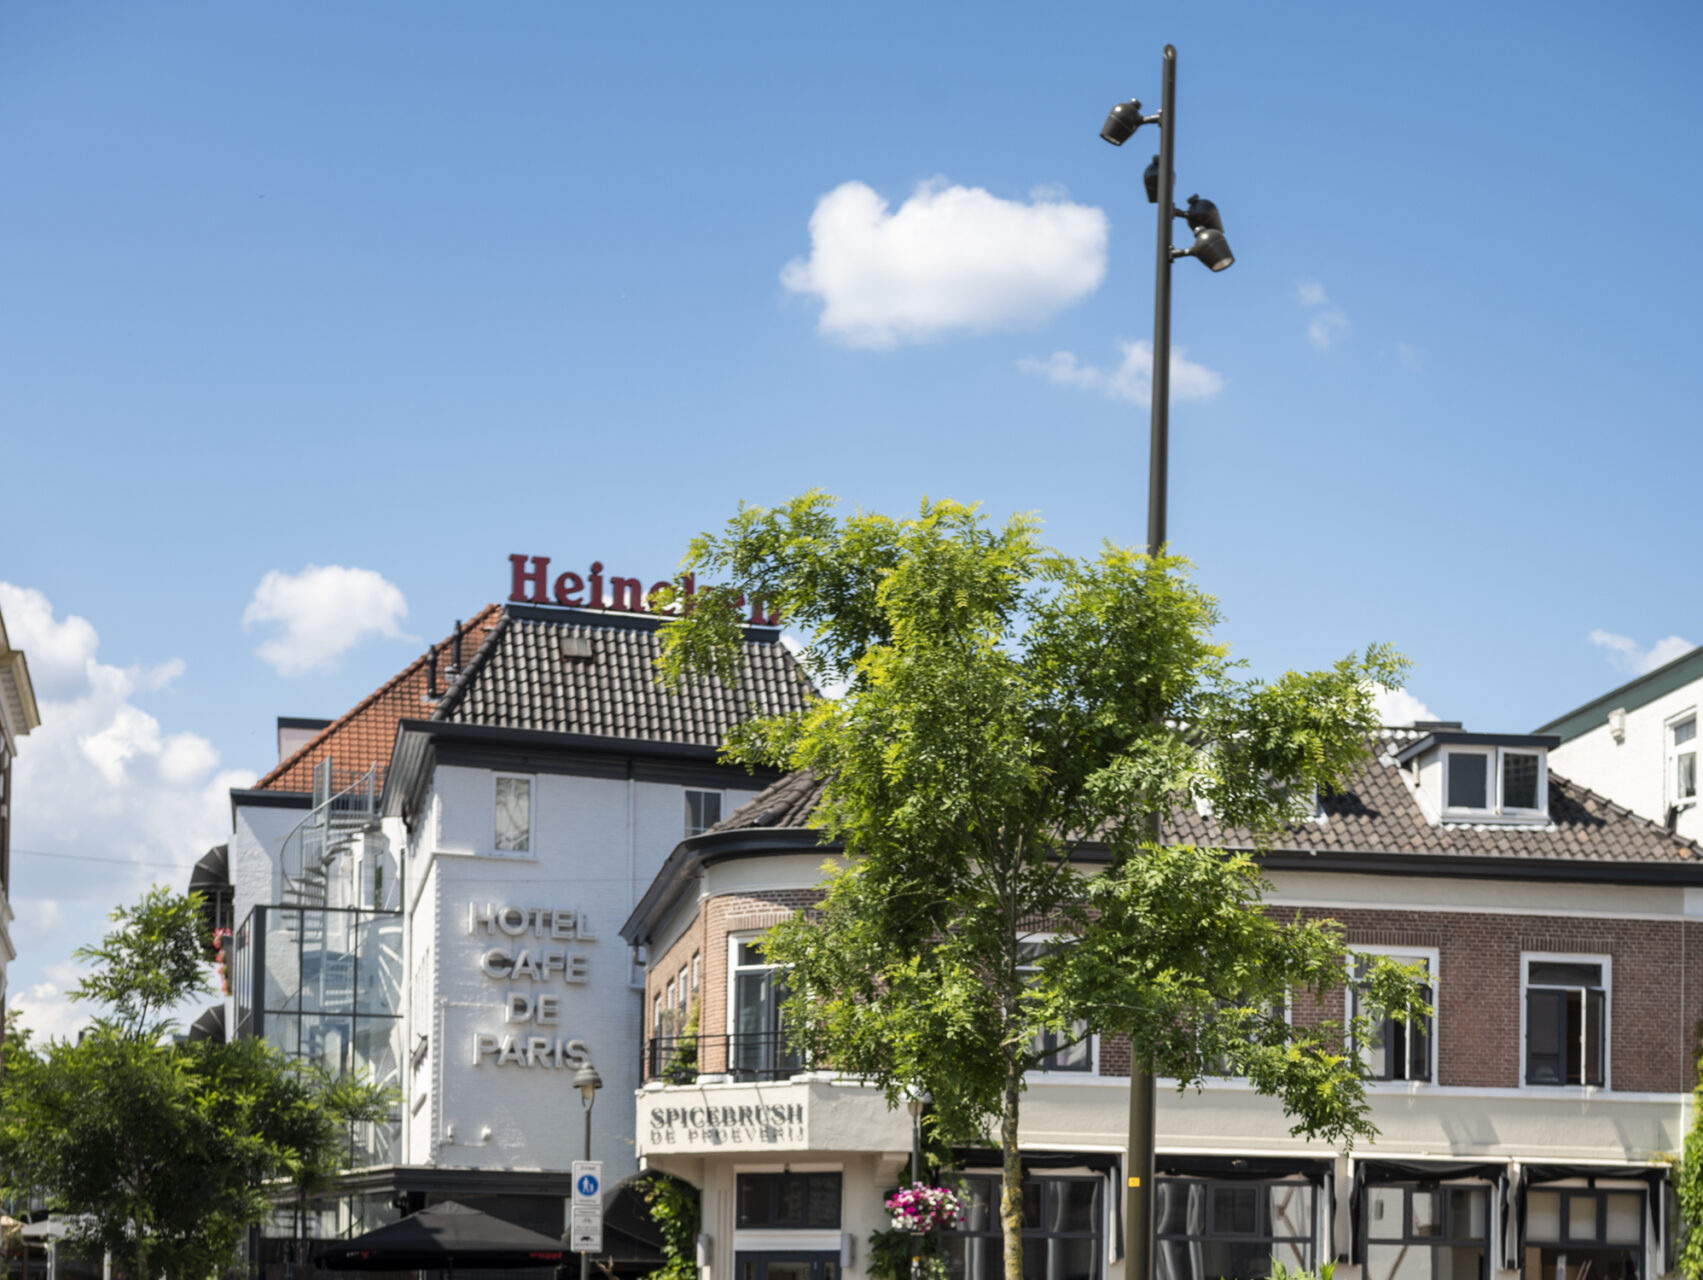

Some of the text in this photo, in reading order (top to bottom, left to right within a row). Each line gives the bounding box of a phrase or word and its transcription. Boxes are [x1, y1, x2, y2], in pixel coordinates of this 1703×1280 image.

[469, 902, 597, 941] HOTEL
[481, 948, 588, 984] CAFE
[505, 992, 558, 1025] DE
[473, 1033, 591, 1070] PARIS
[651, 1104, 803, 1128] SPICEBRUSH
[650, 1129, 676, 1144] DE
